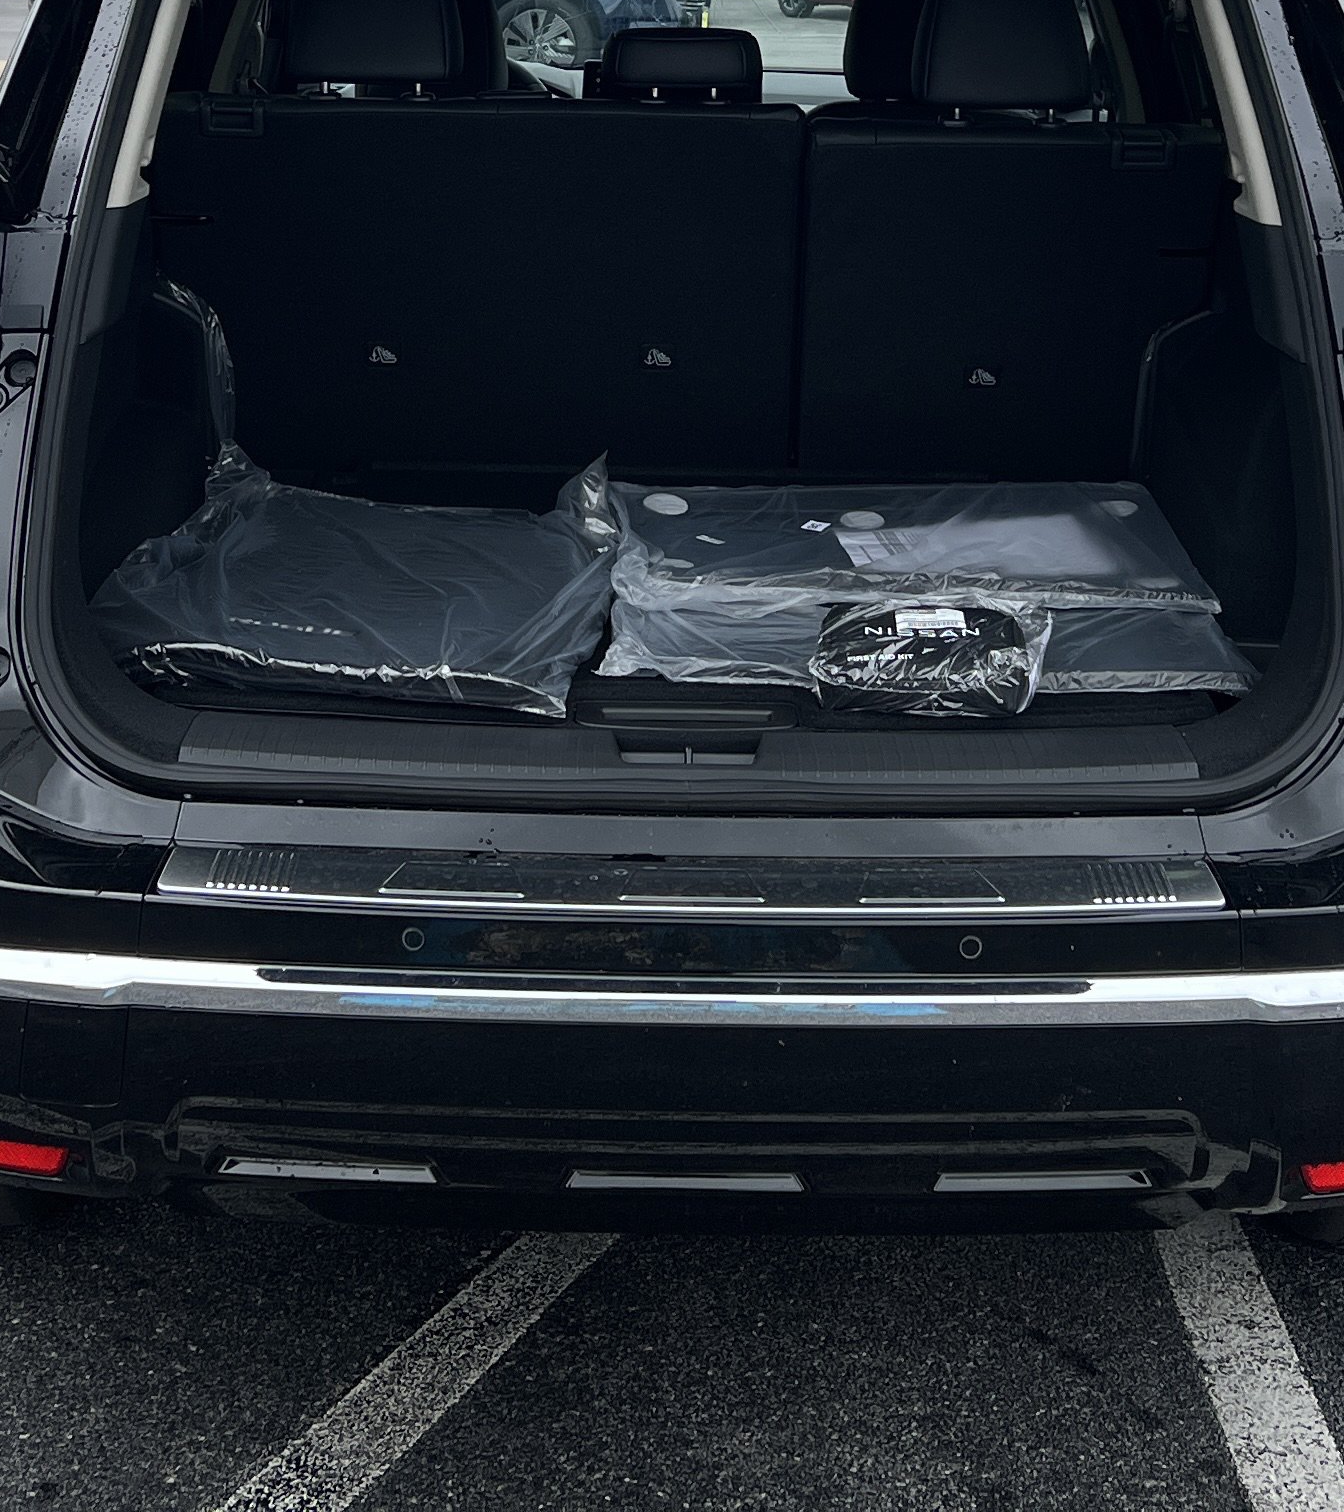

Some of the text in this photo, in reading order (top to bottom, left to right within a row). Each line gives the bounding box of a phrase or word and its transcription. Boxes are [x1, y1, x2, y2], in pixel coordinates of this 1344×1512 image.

[864, 627, 980, 638] NISSAN
[847, 654, 875, 662] FIRST
[878, 653, 896, 661] AID
